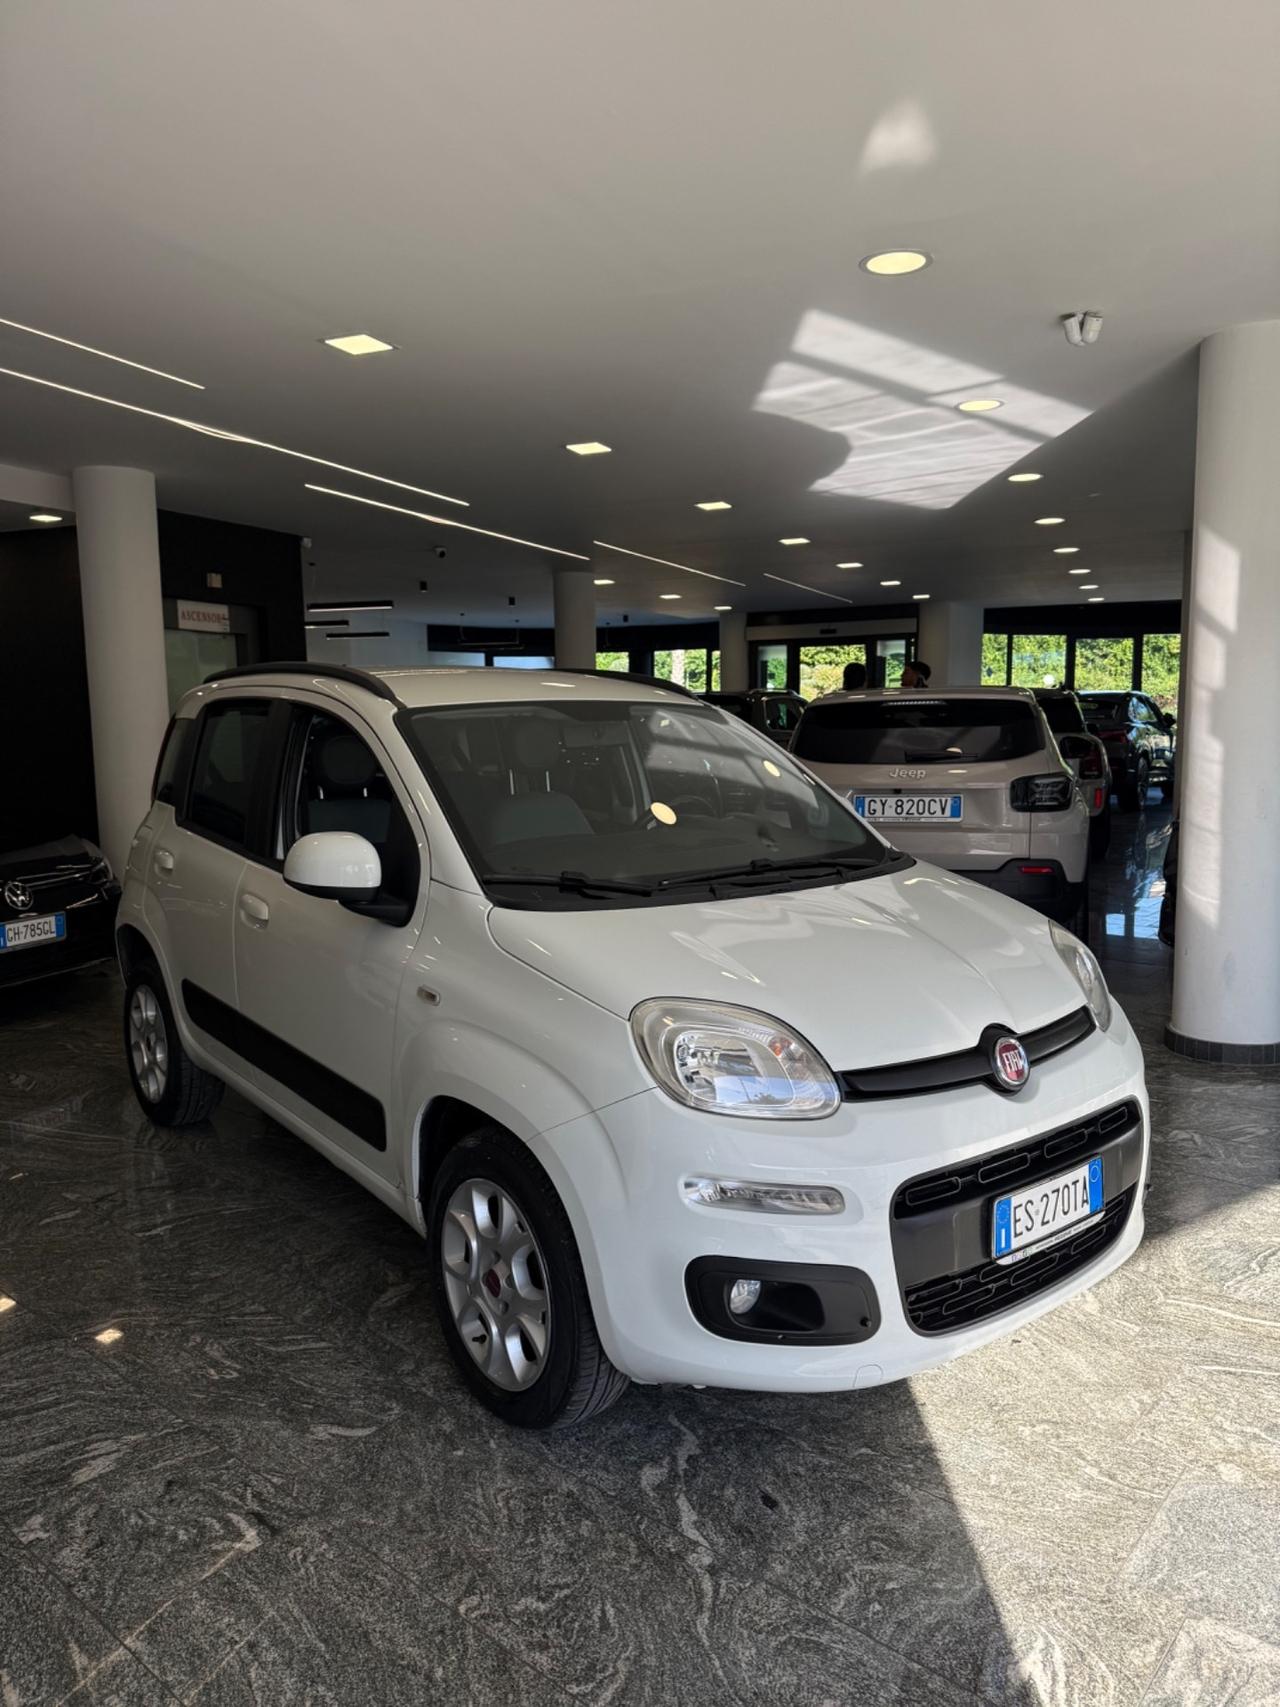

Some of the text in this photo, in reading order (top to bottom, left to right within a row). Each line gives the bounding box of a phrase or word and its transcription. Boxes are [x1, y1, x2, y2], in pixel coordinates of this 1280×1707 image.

[889, 768, 927, 779] Jeep
[868, 799, 948, 815] GY 820CV
[1002, 1049, 1023, 1072] FIAT
[1013, 1199, 1034, 1238] ES
[1040, 1175, 1089, 1227] 270TA
